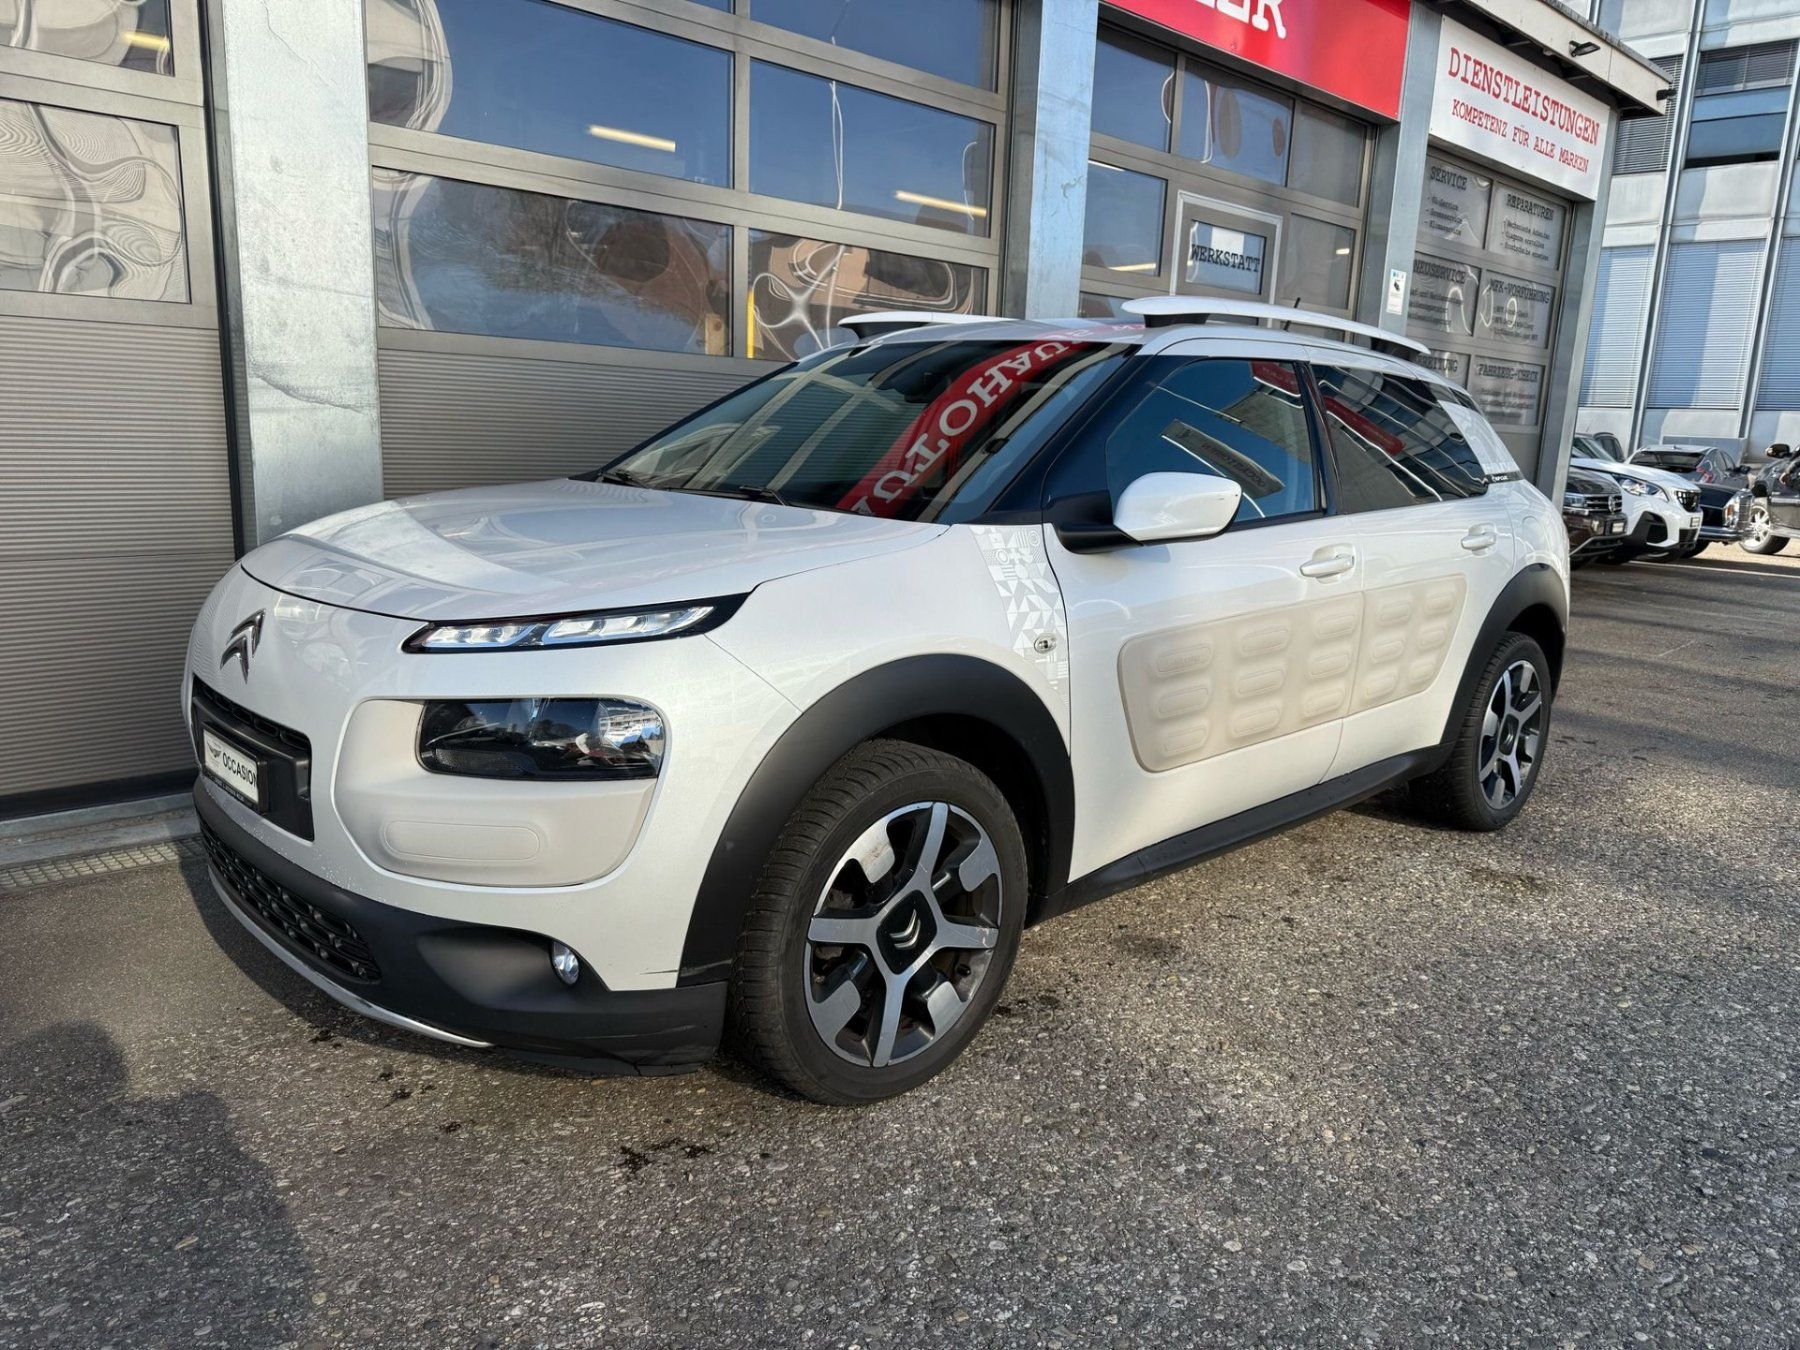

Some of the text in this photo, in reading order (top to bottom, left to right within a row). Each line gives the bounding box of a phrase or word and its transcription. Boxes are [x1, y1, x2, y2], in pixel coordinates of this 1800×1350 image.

[1448, 47, 1600, 146] DIENSTLEISTUNGEN
[1452, 98, 1589, 173] KOMPETENZ FÜR ALLE MARKEN
[1430, 165, 1468, 191] SERVICE
[1506, 193, 1554, 221] REPARATUREN
[1191, 243, 1260, 272] WERKSTATT
